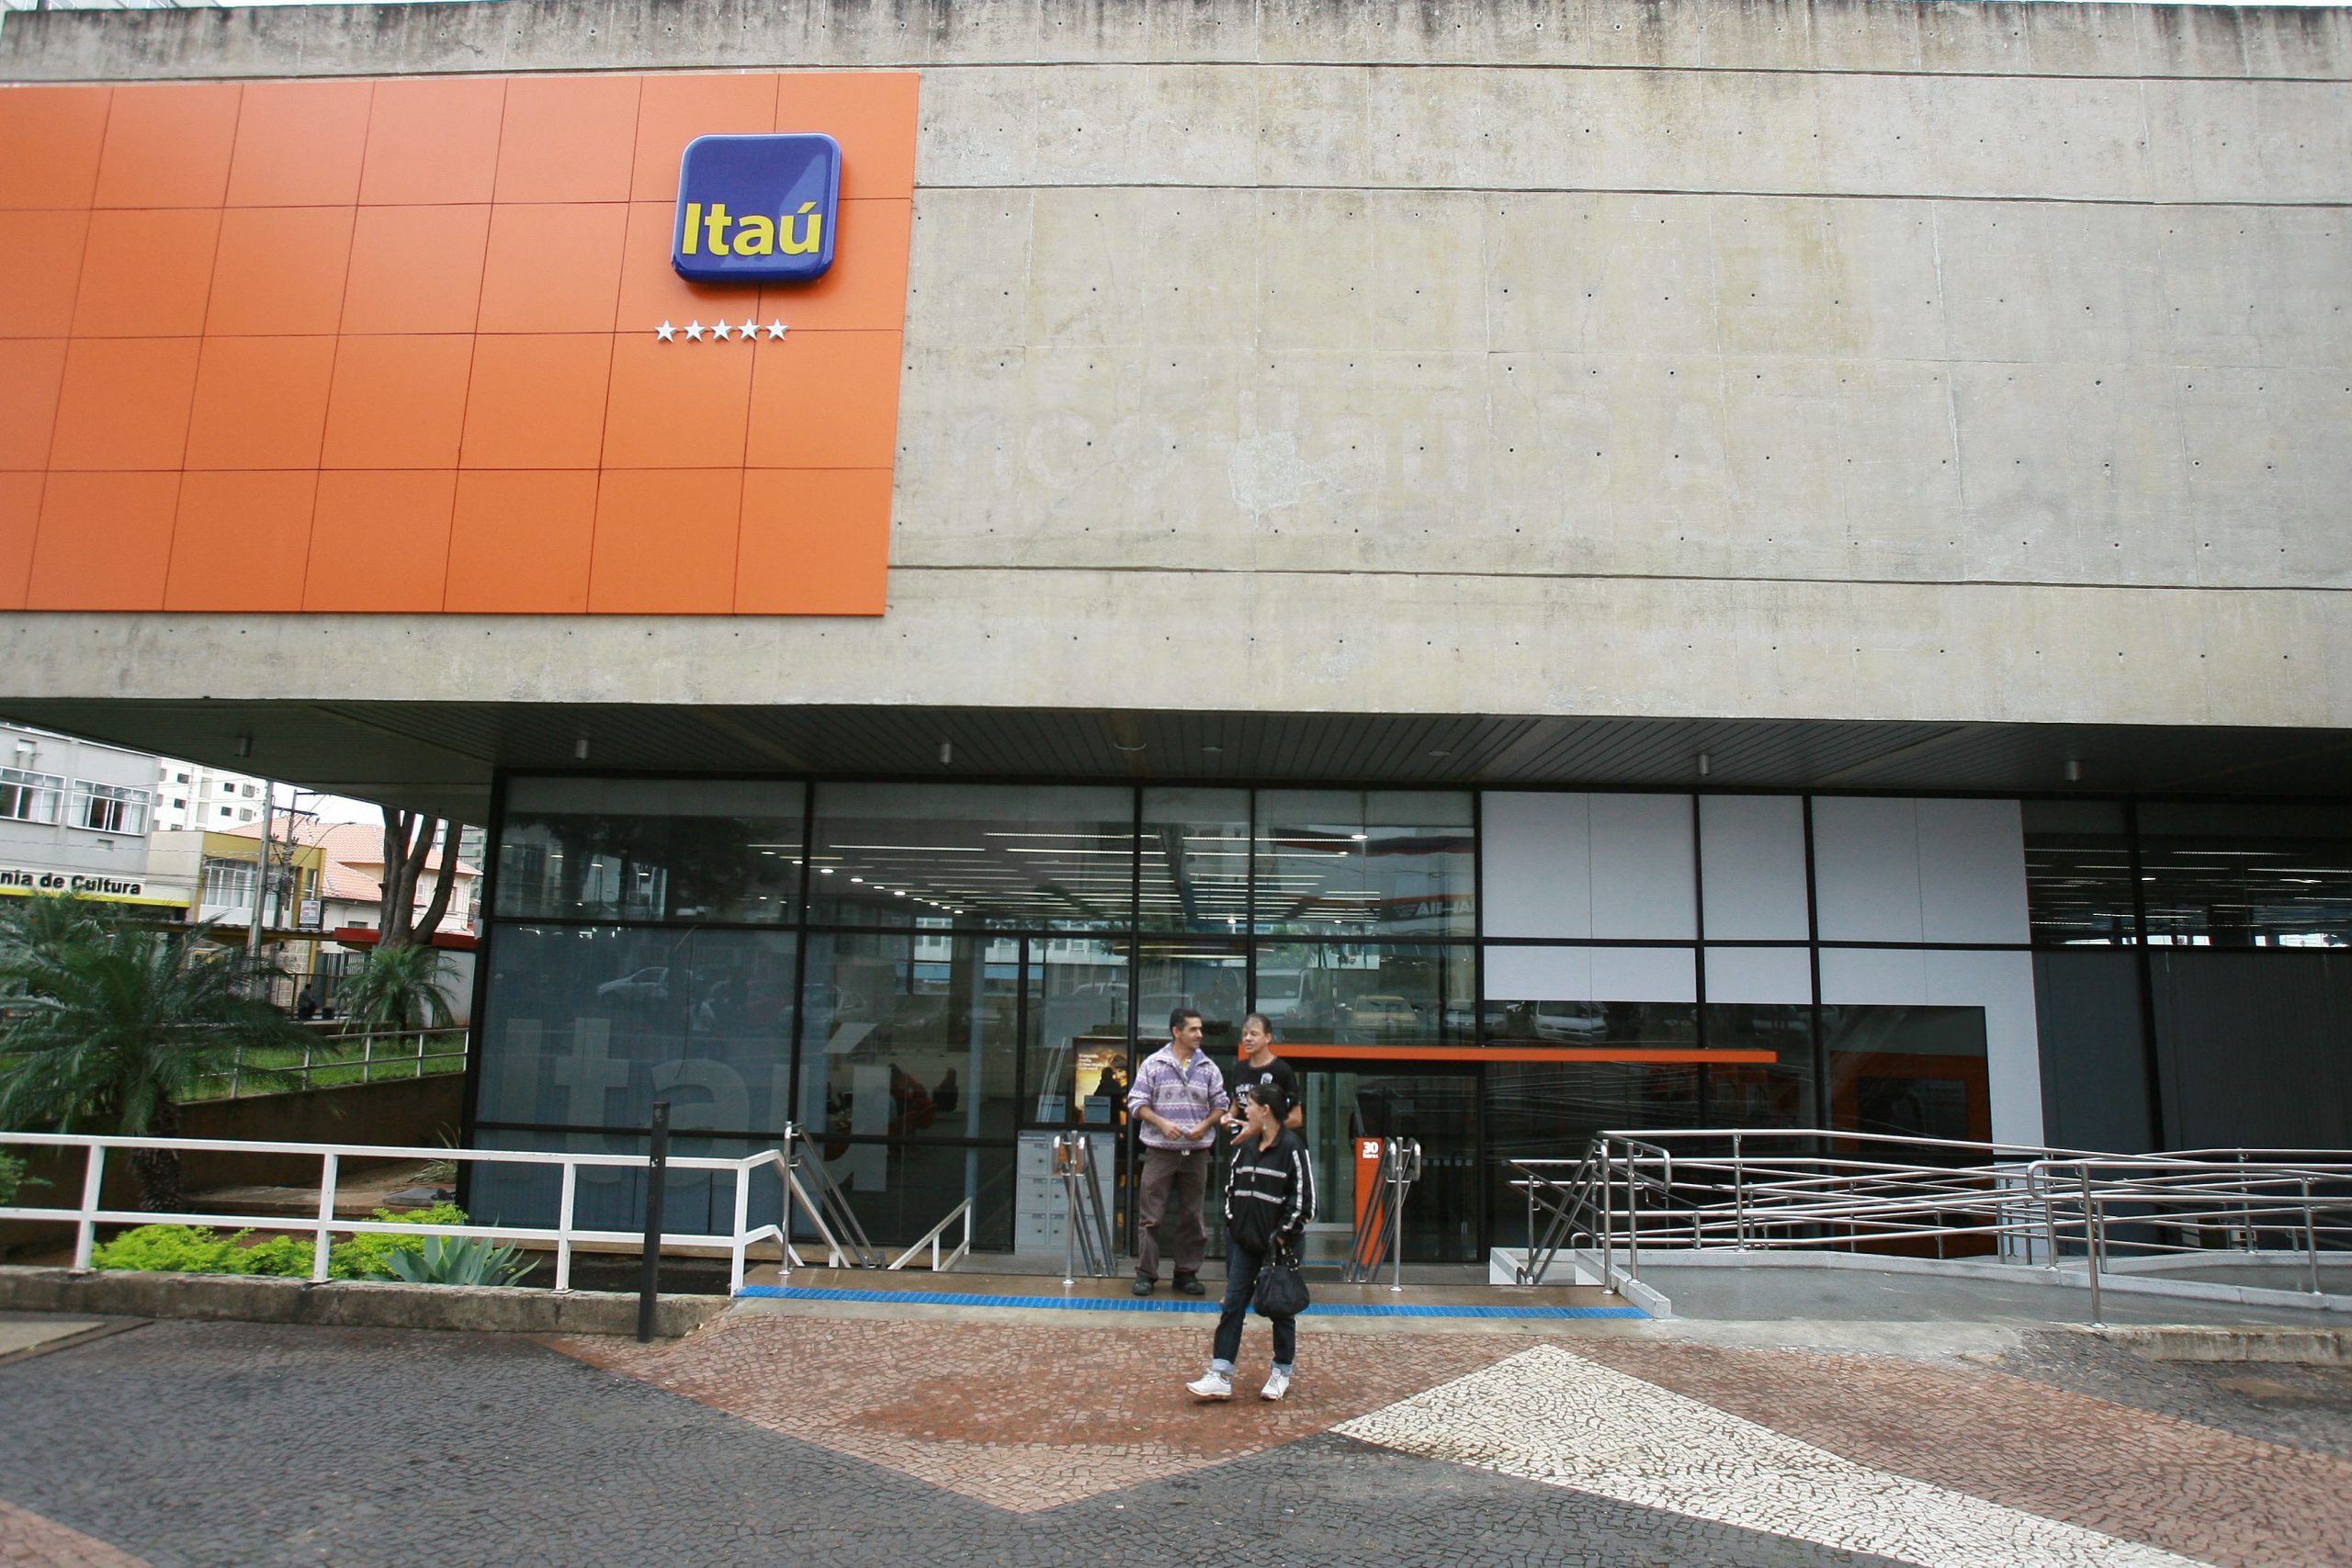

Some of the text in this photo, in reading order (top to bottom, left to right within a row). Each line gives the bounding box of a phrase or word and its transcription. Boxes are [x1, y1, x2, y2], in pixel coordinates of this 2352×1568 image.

[682, 202, 822, 256] Itaú
[40, 872, 65, 888] de
[72, 874, 141, 895] Cultura
[1363, 1141, 1379, 1154] 30
